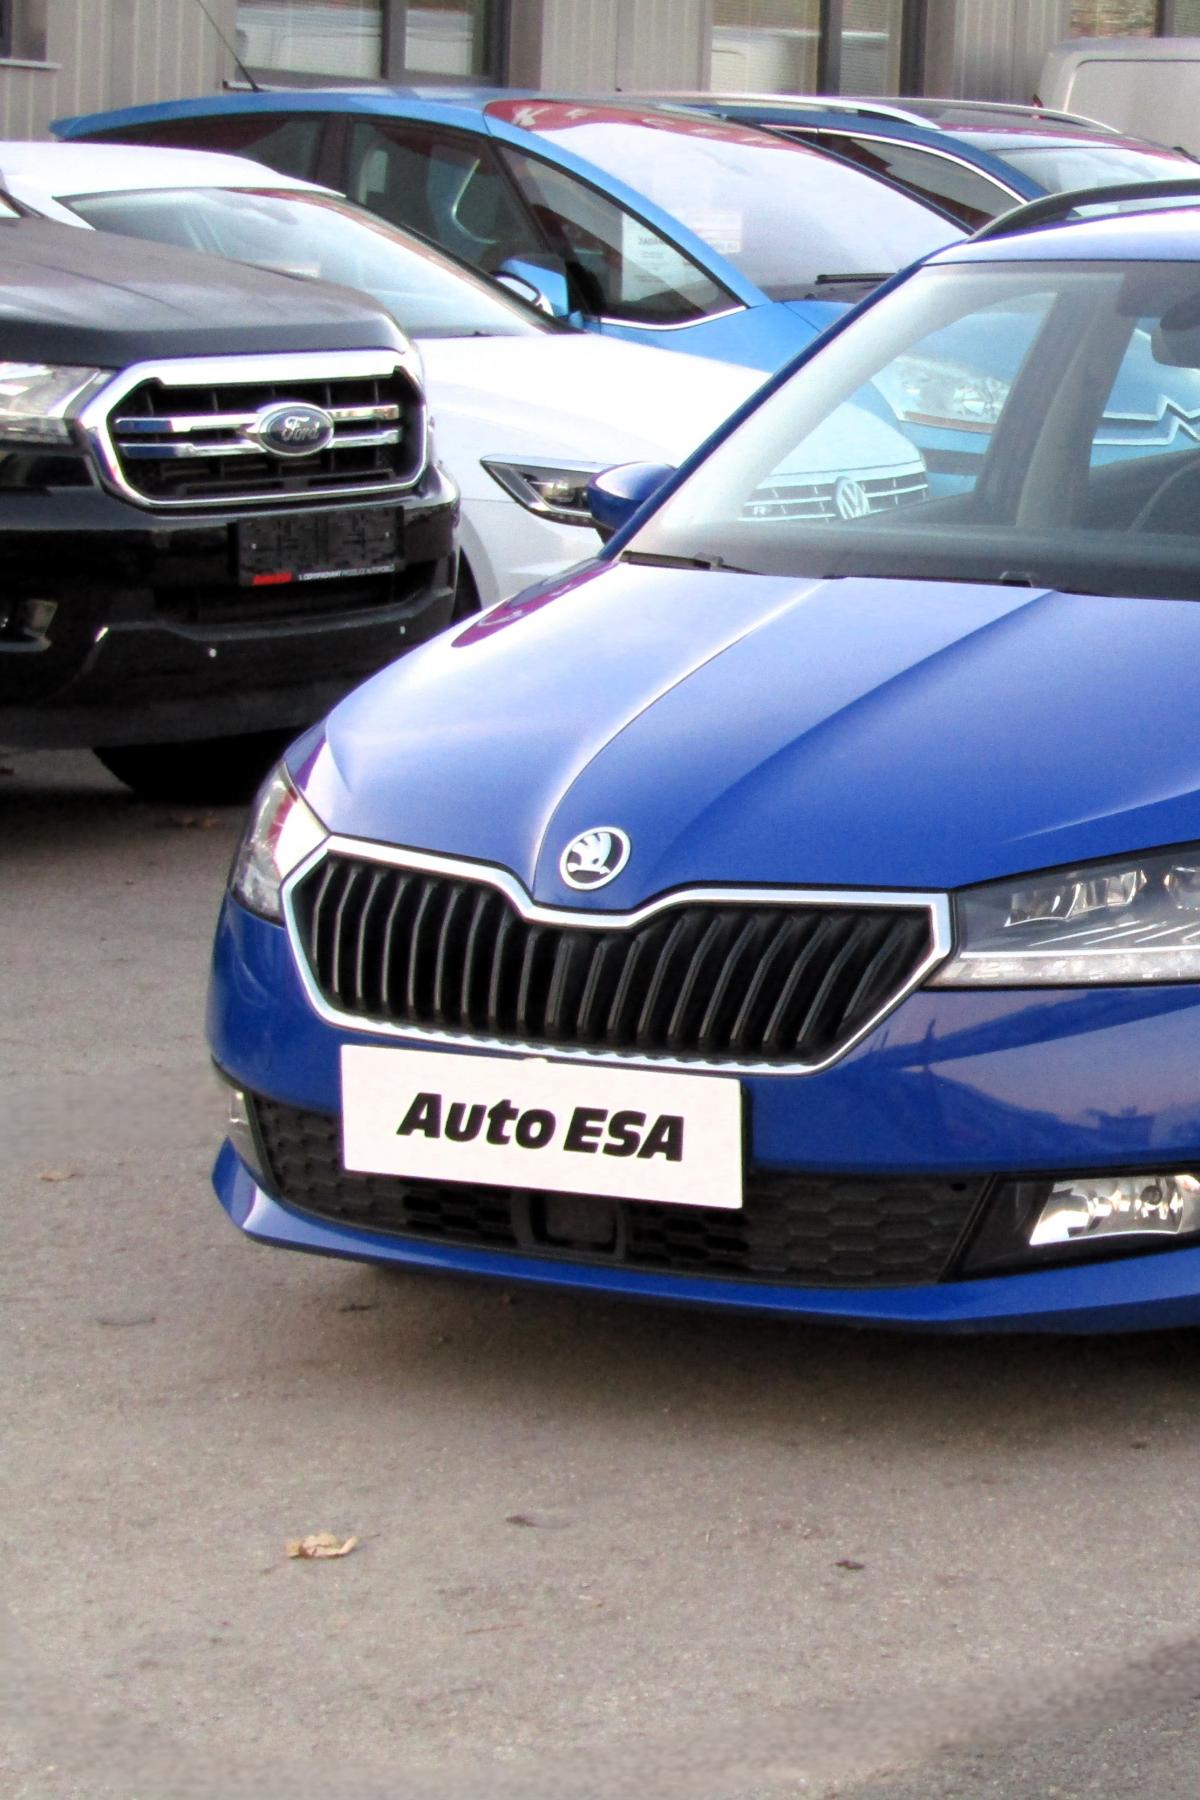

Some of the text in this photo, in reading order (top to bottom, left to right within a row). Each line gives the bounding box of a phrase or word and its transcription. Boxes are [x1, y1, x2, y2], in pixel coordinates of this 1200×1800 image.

[281, 416, 320, 441] Ford
[396, 1092, 684, 1162] Auto ESA
